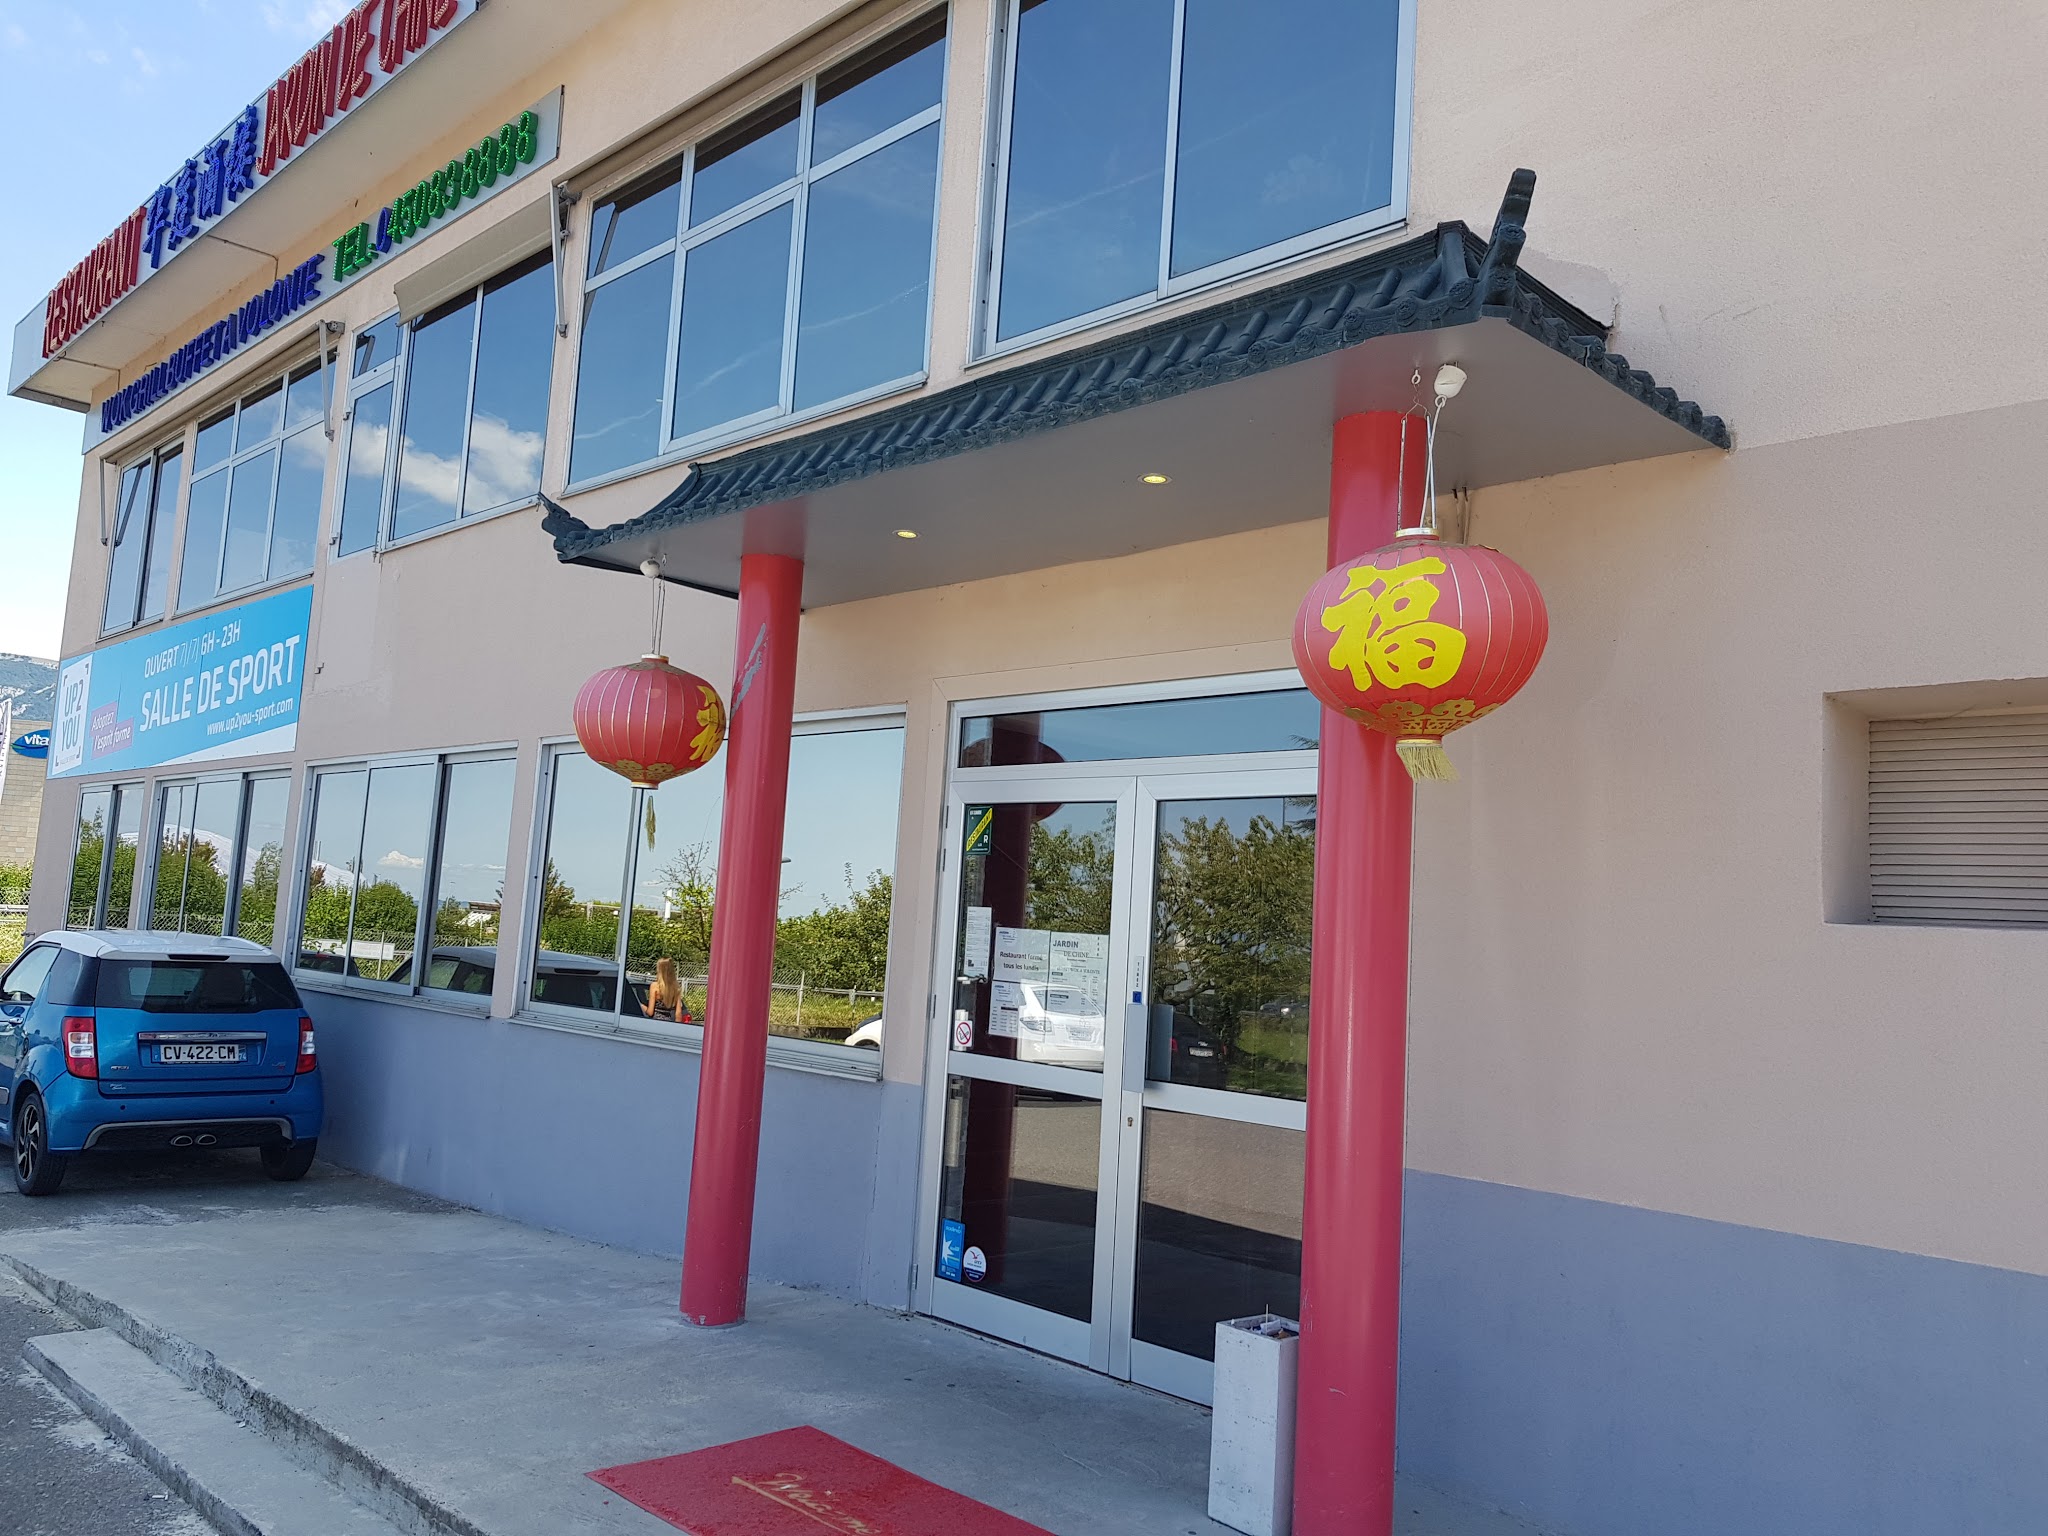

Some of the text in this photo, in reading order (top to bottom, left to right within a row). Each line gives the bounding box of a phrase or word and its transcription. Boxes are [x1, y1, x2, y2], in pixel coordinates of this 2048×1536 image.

[255, 22, 343, 177] JARDIN
[336, 0, 379, 112] DE
[375, 110, 539, 255] 0450838888
[42, 205, 147, 359] RESTAURANT
[101, 385, 133, 434] WOK
[129, 361, 169, 416] GRILL
[165, 318, 227, 391] BUFFET
[238, 253, 326, 345] VOLONTE
[144, 644, 180, 679] OUVERT
[200, 629, 216, 656] 6H
[220, 619, 242, 649] 23H
[1320, 556, 1467, 692] 福
[64, 679, 84, 718] UP2
[139, 634, 301, 733] SALLE DE SPORT
[61, 713, 81, 752] YOU
[206, 697, 294, 737] www.up2you-sport.com
[999, 951, 1027, 961] Restaurant
[1003, 962, 1015, 970] tous
[1015, 962, 1023, 970] les
[1052, 939, 1079, 949] JARDIN
[163, 1045, 236, 1060] CV-422-CM
